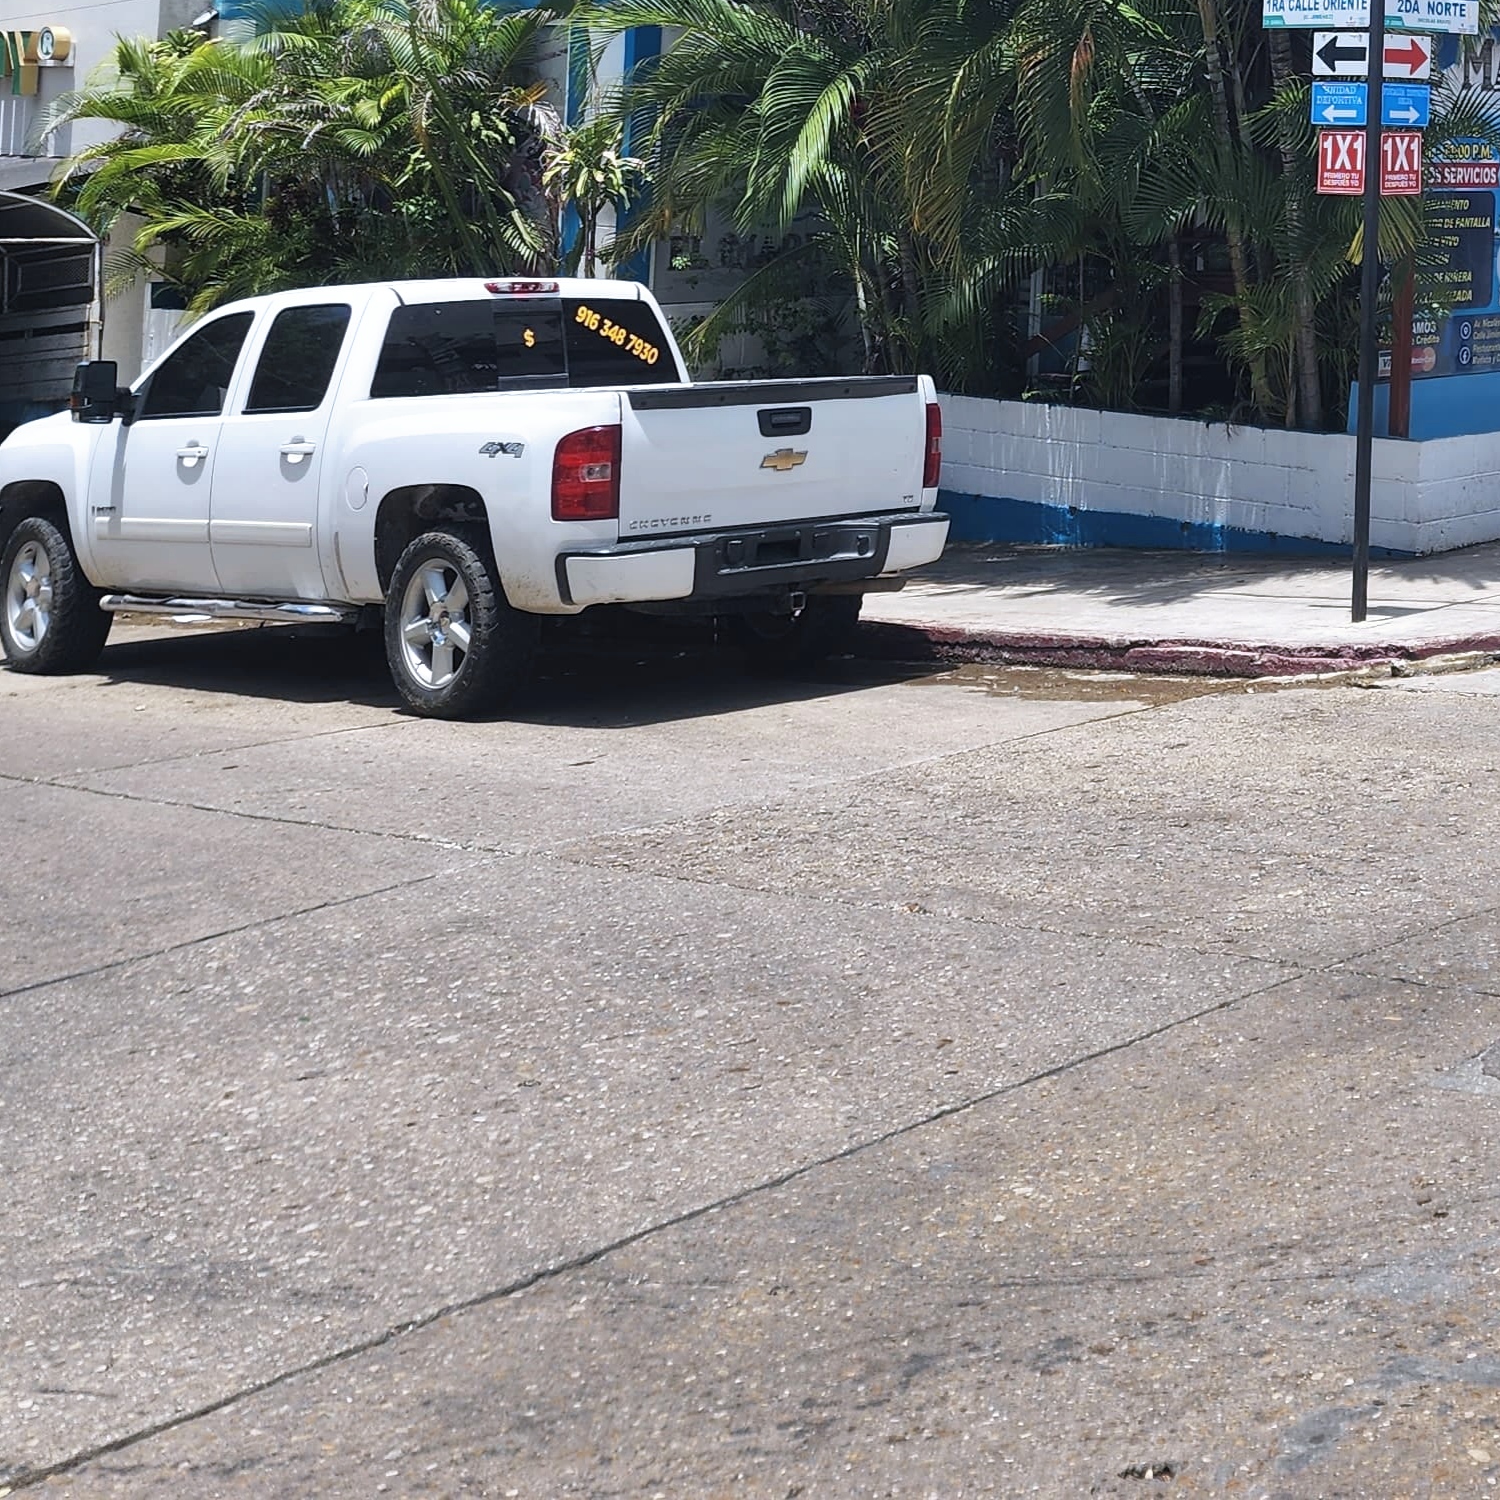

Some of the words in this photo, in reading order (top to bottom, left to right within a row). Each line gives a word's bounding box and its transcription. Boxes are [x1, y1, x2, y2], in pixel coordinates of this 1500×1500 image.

[1428, 0, 1466, 17] NORTE
[1316, 96, 1362, 105] DEPORTIVA
[1324, 135, 1362, 170] 1X1
[1384, 137, 1418, 171] 1X1
[1444, 167, 1496, 184] SERVICIOS
[1444, 218, 1454, 228] DE
[524, 328, 535, 347] $
[576, 306, 600, 330] 916
[600, 318, 626, 345] 348
[625, 334, 658, 364] 7930
[630, 514, 712, 530] CHEYENNE
